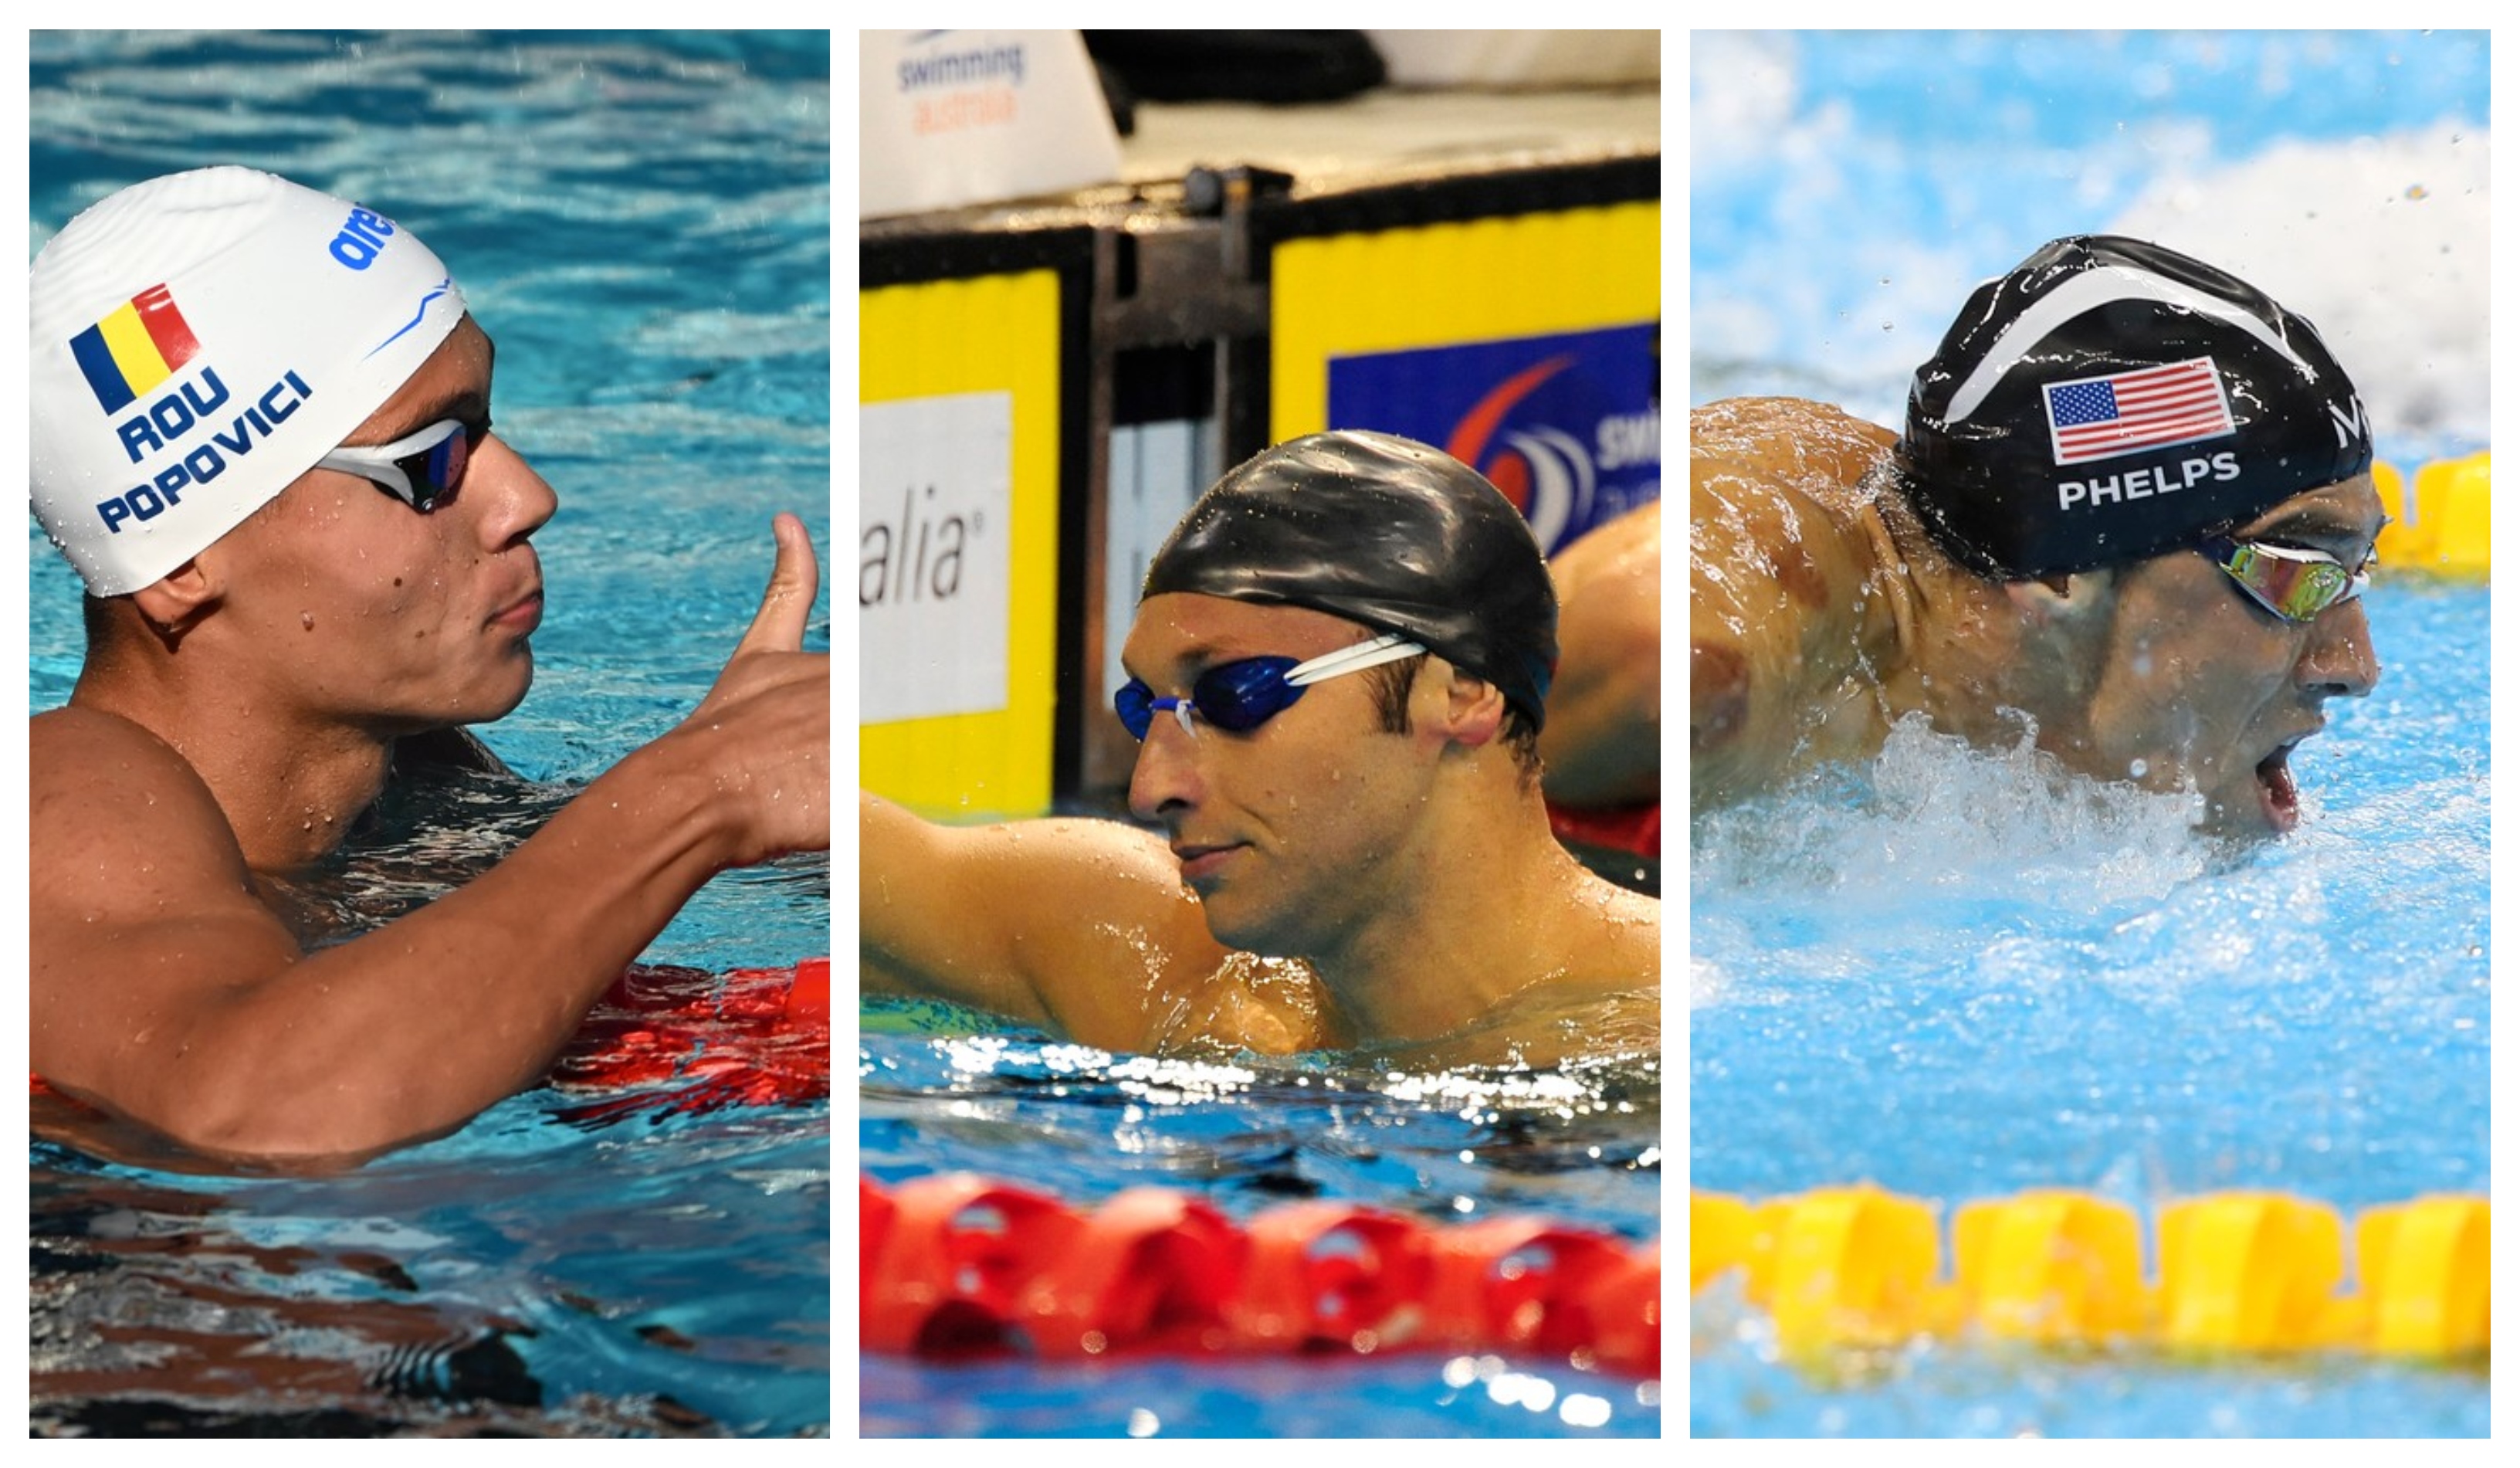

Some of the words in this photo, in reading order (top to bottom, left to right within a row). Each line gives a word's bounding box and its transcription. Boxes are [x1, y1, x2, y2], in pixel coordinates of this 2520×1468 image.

[898, 43, 1024, 92] swimming
[329, 205, 395, 270] are
[116, 366, 230, 464] ROU
[97, 370, 313, 534] POPOVICI
[2058, 453, 2241, 510] PHELPS
